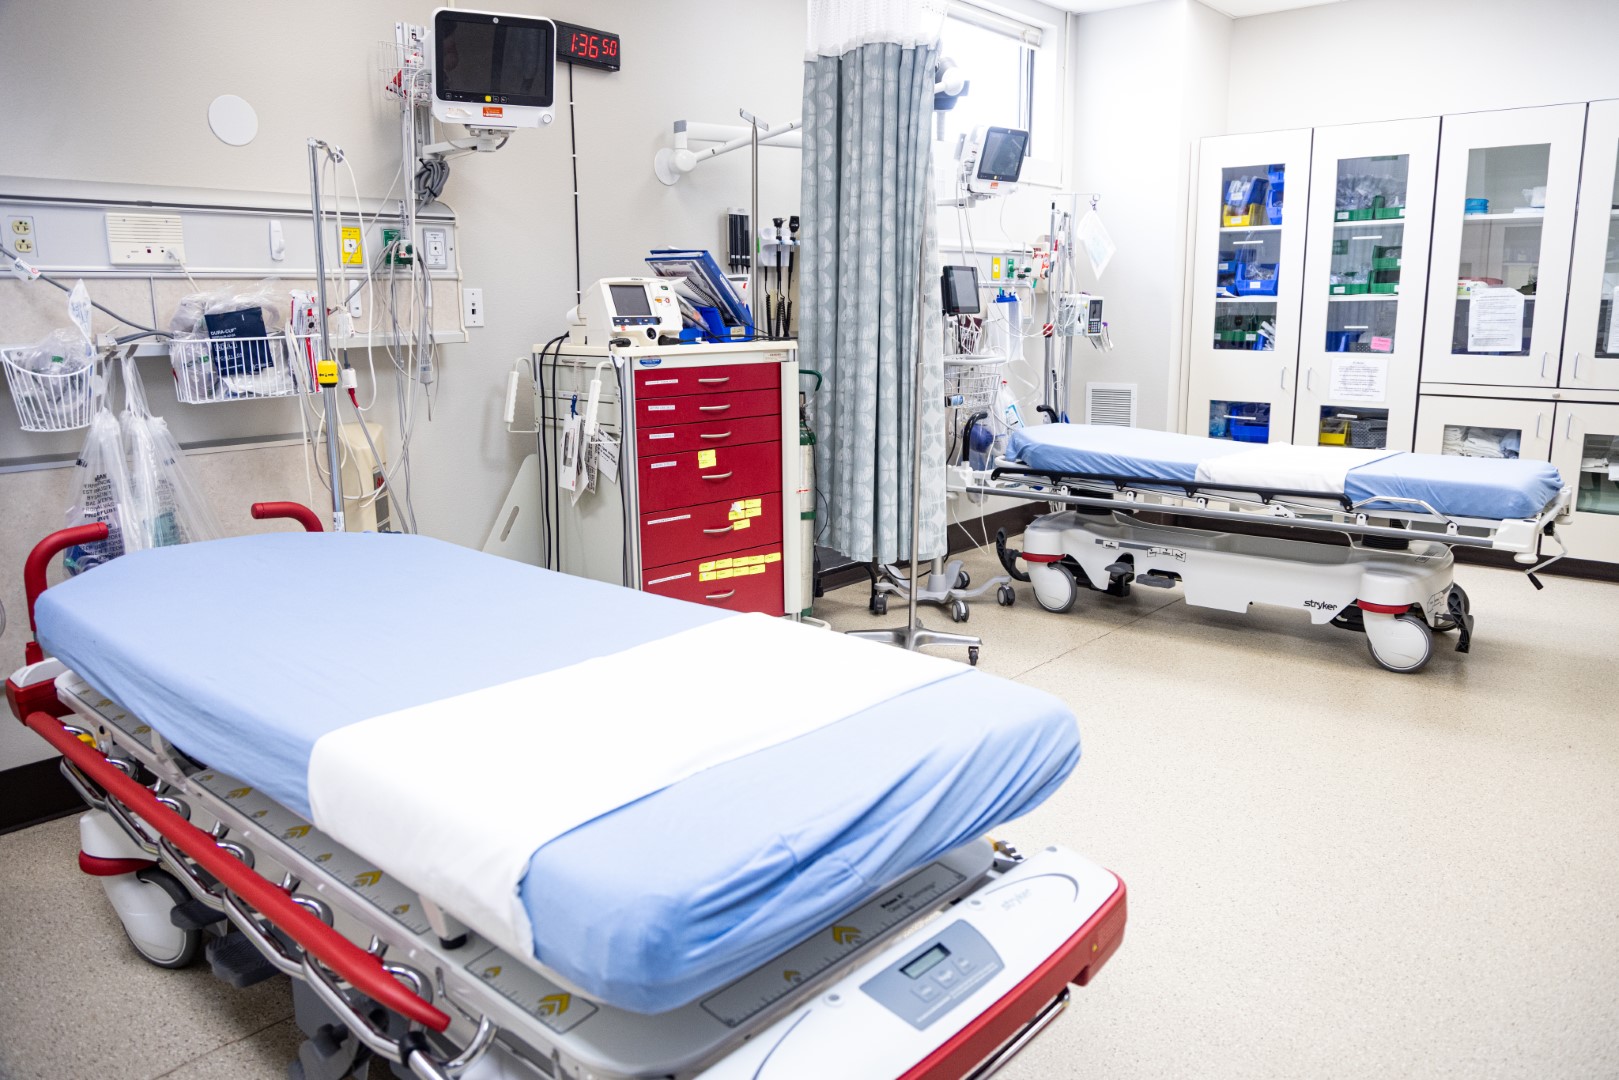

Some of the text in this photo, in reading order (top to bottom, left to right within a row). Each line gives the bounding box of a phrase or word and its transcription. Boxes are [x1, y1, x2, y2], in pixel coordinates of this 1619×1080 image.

[571, 33, 617, 58] 1:36 50
[1303, 599, 1338, 610] stryker
